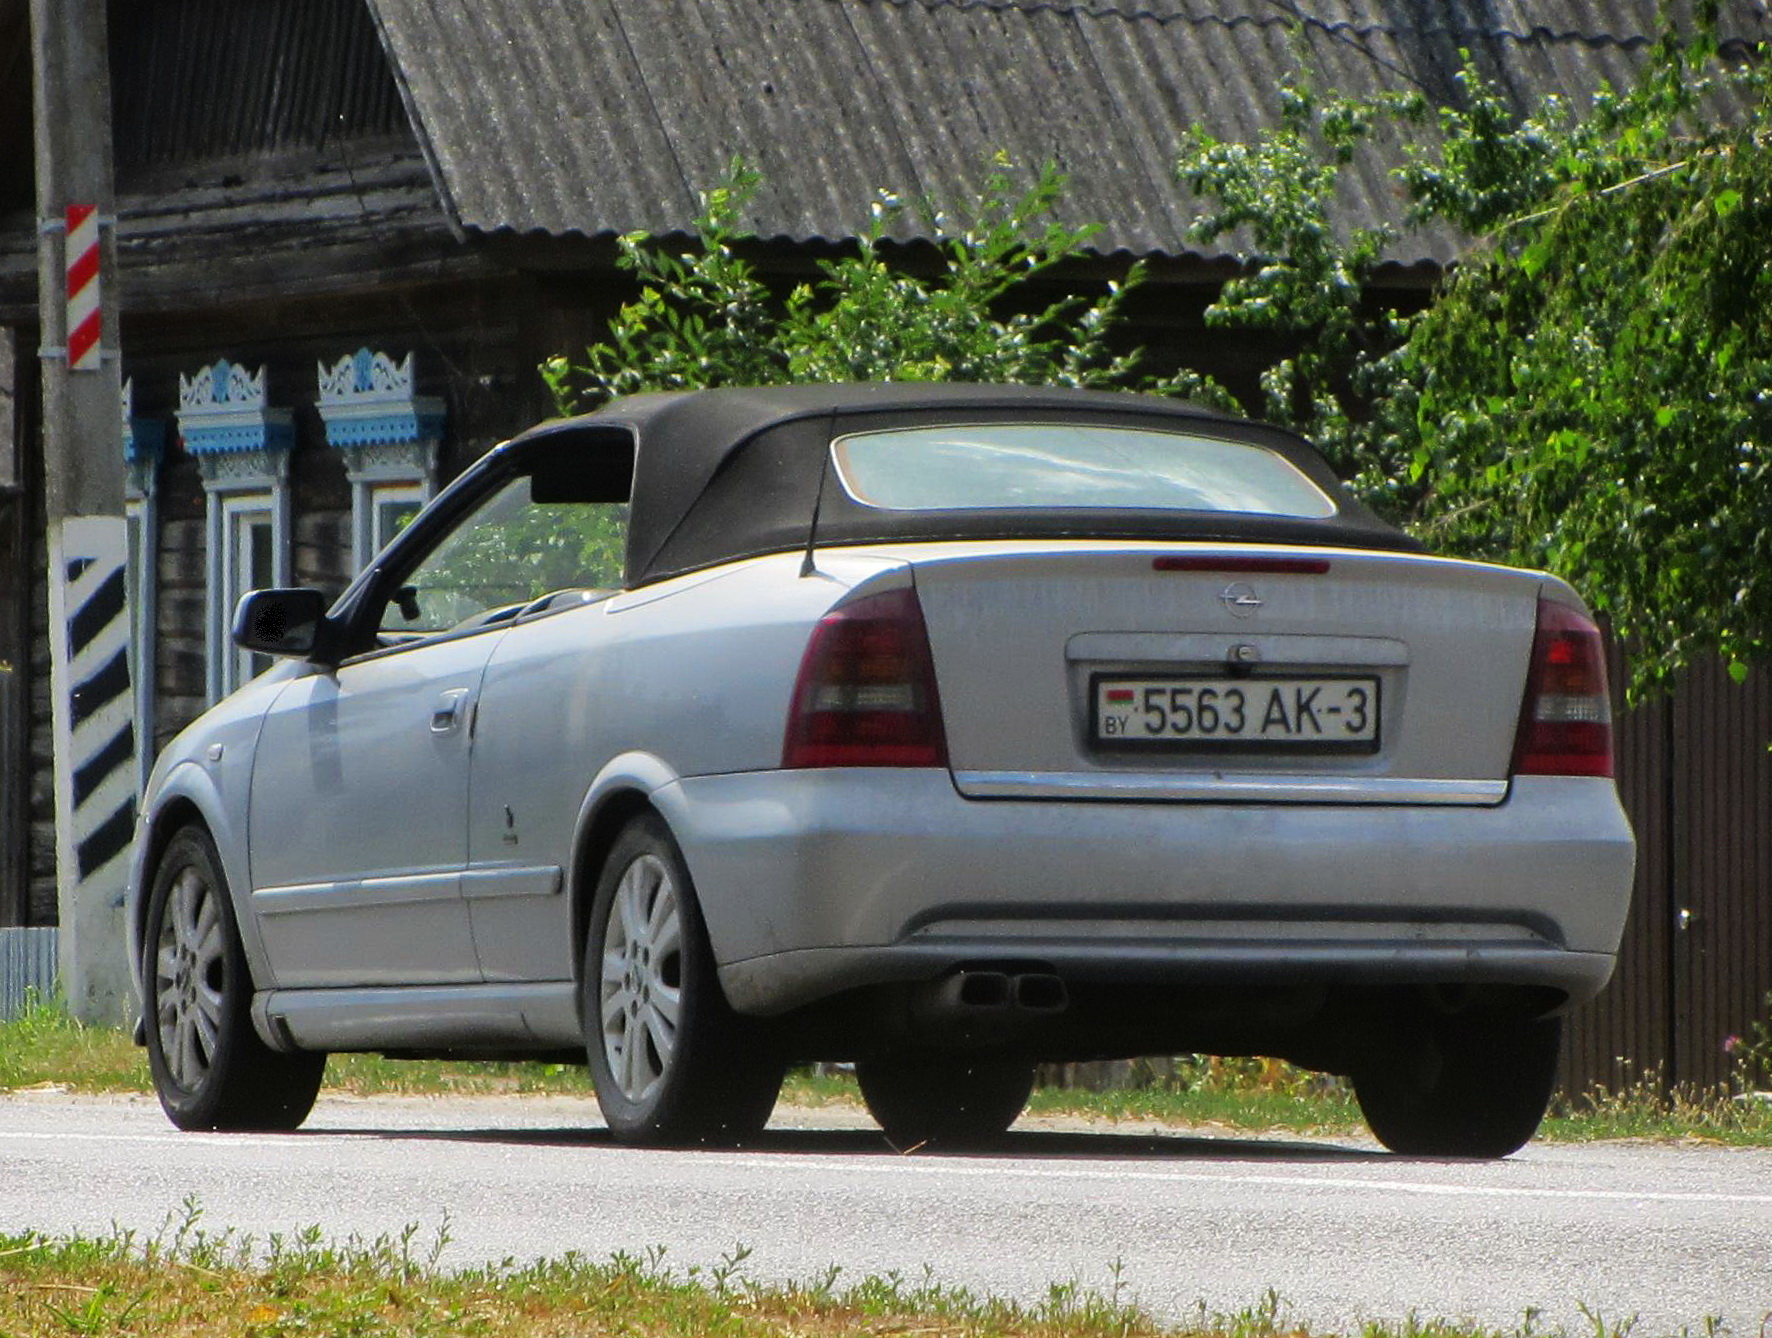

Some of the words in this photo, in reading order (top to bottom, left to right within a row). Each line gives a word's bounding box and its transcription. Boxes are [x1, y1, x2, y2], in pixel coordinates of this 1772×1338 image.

[1105, 716, 1128, 735] BY
[1144, 688, 1245, 734] 5563
[1261, 687, 1367, 734] AK-3
